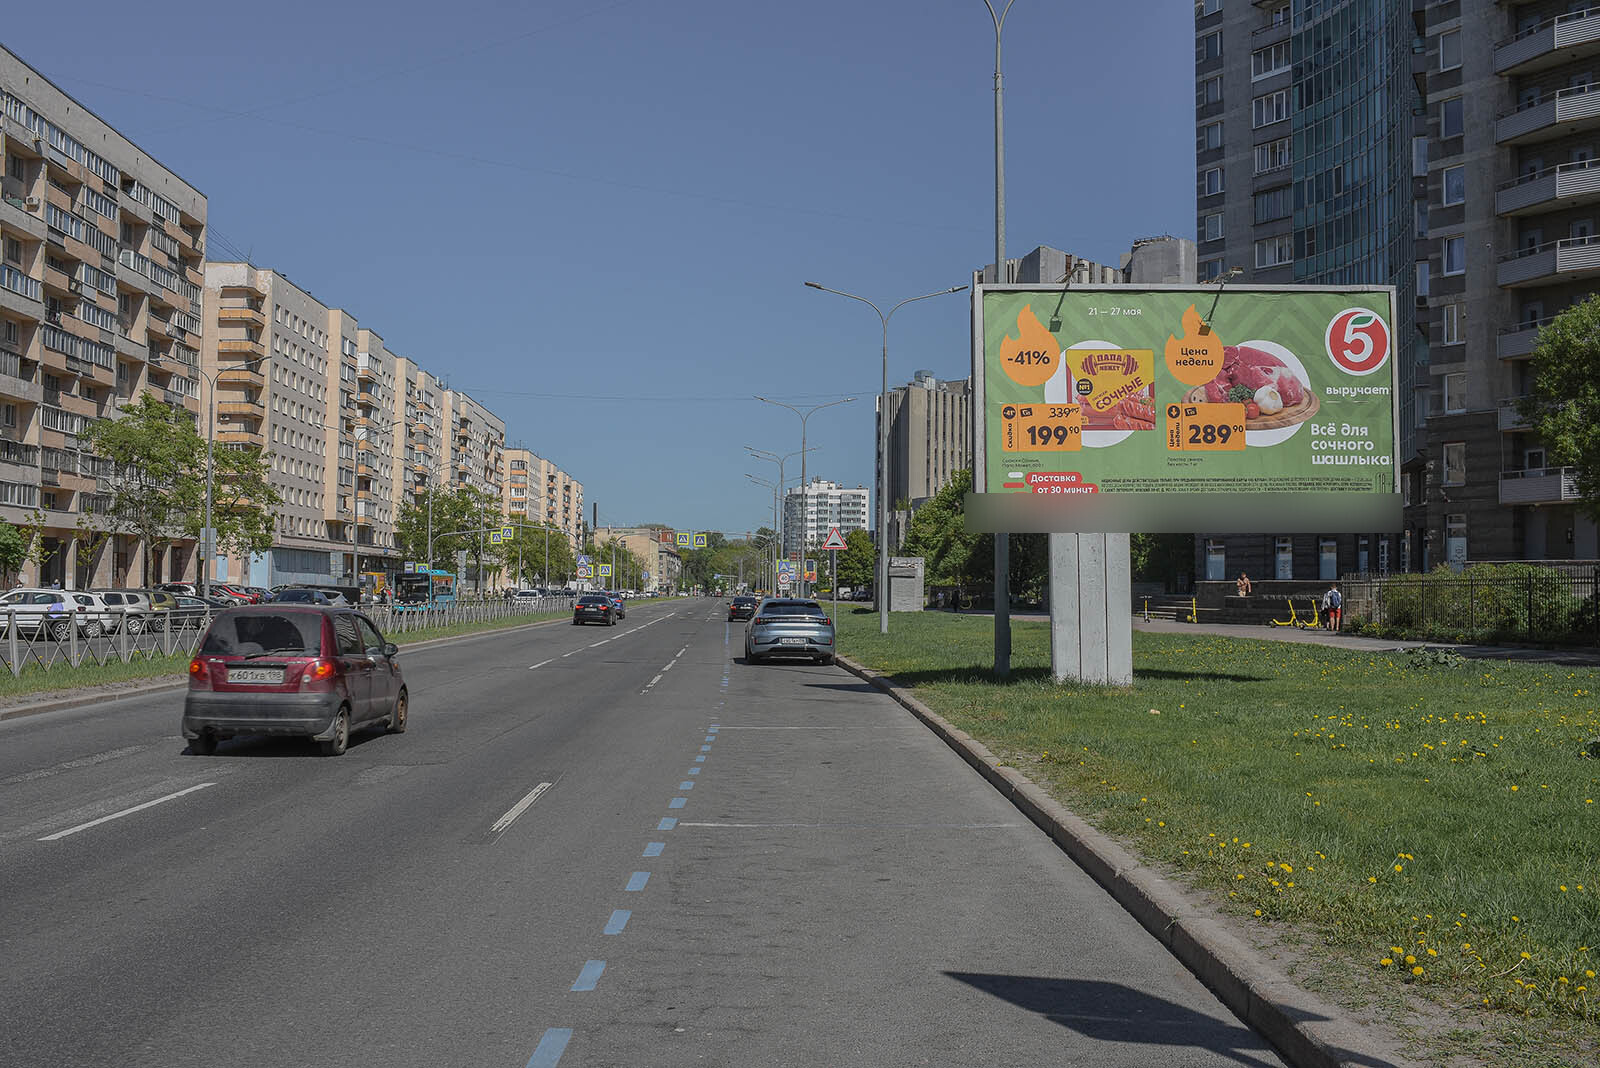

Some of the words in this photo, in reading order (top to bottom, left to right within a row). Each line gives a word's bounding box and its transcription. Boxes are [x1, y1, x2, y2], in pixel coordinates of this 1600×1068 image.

[1088, 307, 1098, 316] 21
[1111, 307, 1120, 316] 27
[1181, 347, 1208, 356] Цена
[1007, 350, 1051, 365] -41%
[1175, 357, 1214, 366] недели
[1095, 376, 1144, 410] СОЧНЫЕ
[1049, 407, 1071, 418] 339
[1188, 424, 1232, 444] 289
[1232, 425, 1244, 433] 90
[1310, 422, 1336, 435] Всё
[1341, 423, 1368, 436] для
[1027, 425, 1068, 445] 199
[1068, 426, 1080, 434] 90
[1311, 440, 1375, 450] сочного
[1031, 475, 1076, 483] Доставка
